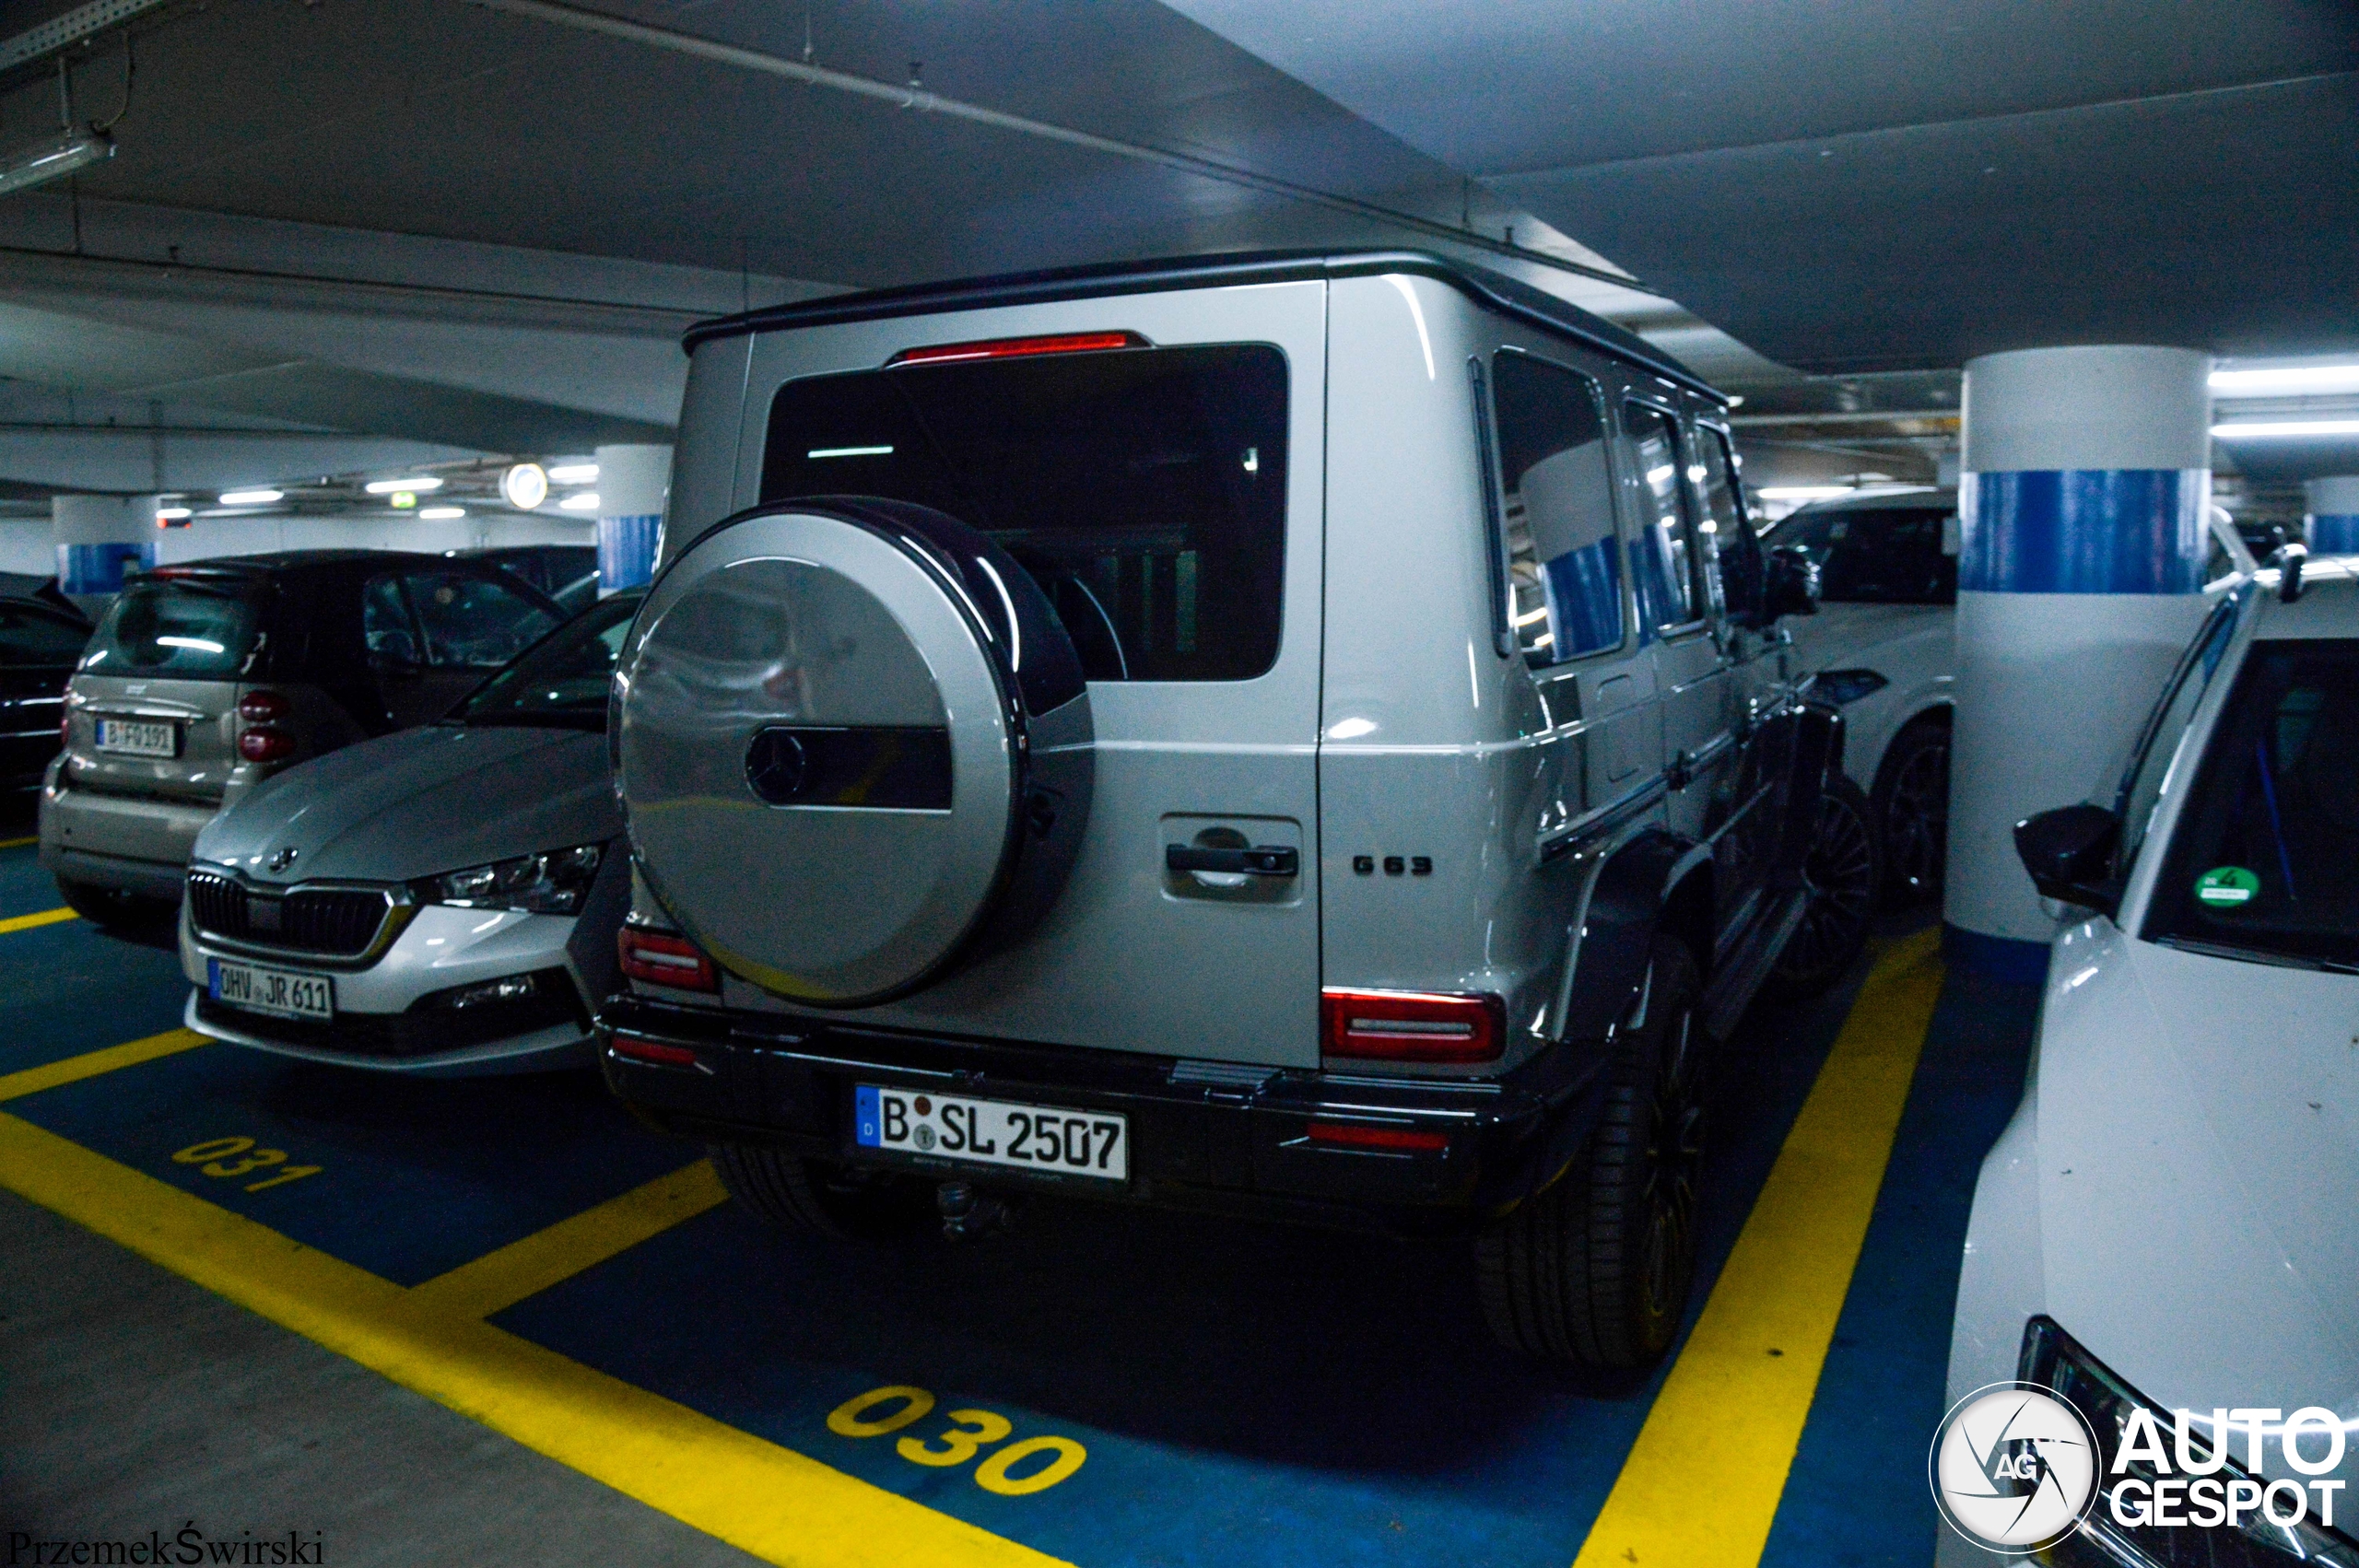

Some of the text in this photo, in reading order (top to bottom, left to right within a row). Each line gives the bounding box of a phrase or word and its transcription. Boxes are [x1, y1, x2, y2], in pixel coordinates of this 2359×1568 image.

[1353, 855, 1433, 876] G63
[2220, 869, 2236, 886] 4
[220, 967, 327, 1012] OHV JR 611
[863, 1122, 874, 1137] D
[883, 1096, 910, 1142] B
[940, 1104, 995, 1154] SL
[1006, 1111, 1120, 1170] 2507
[171, 1136, 323, 1192] 031
[826, 1385, 1087, 1496] 030
